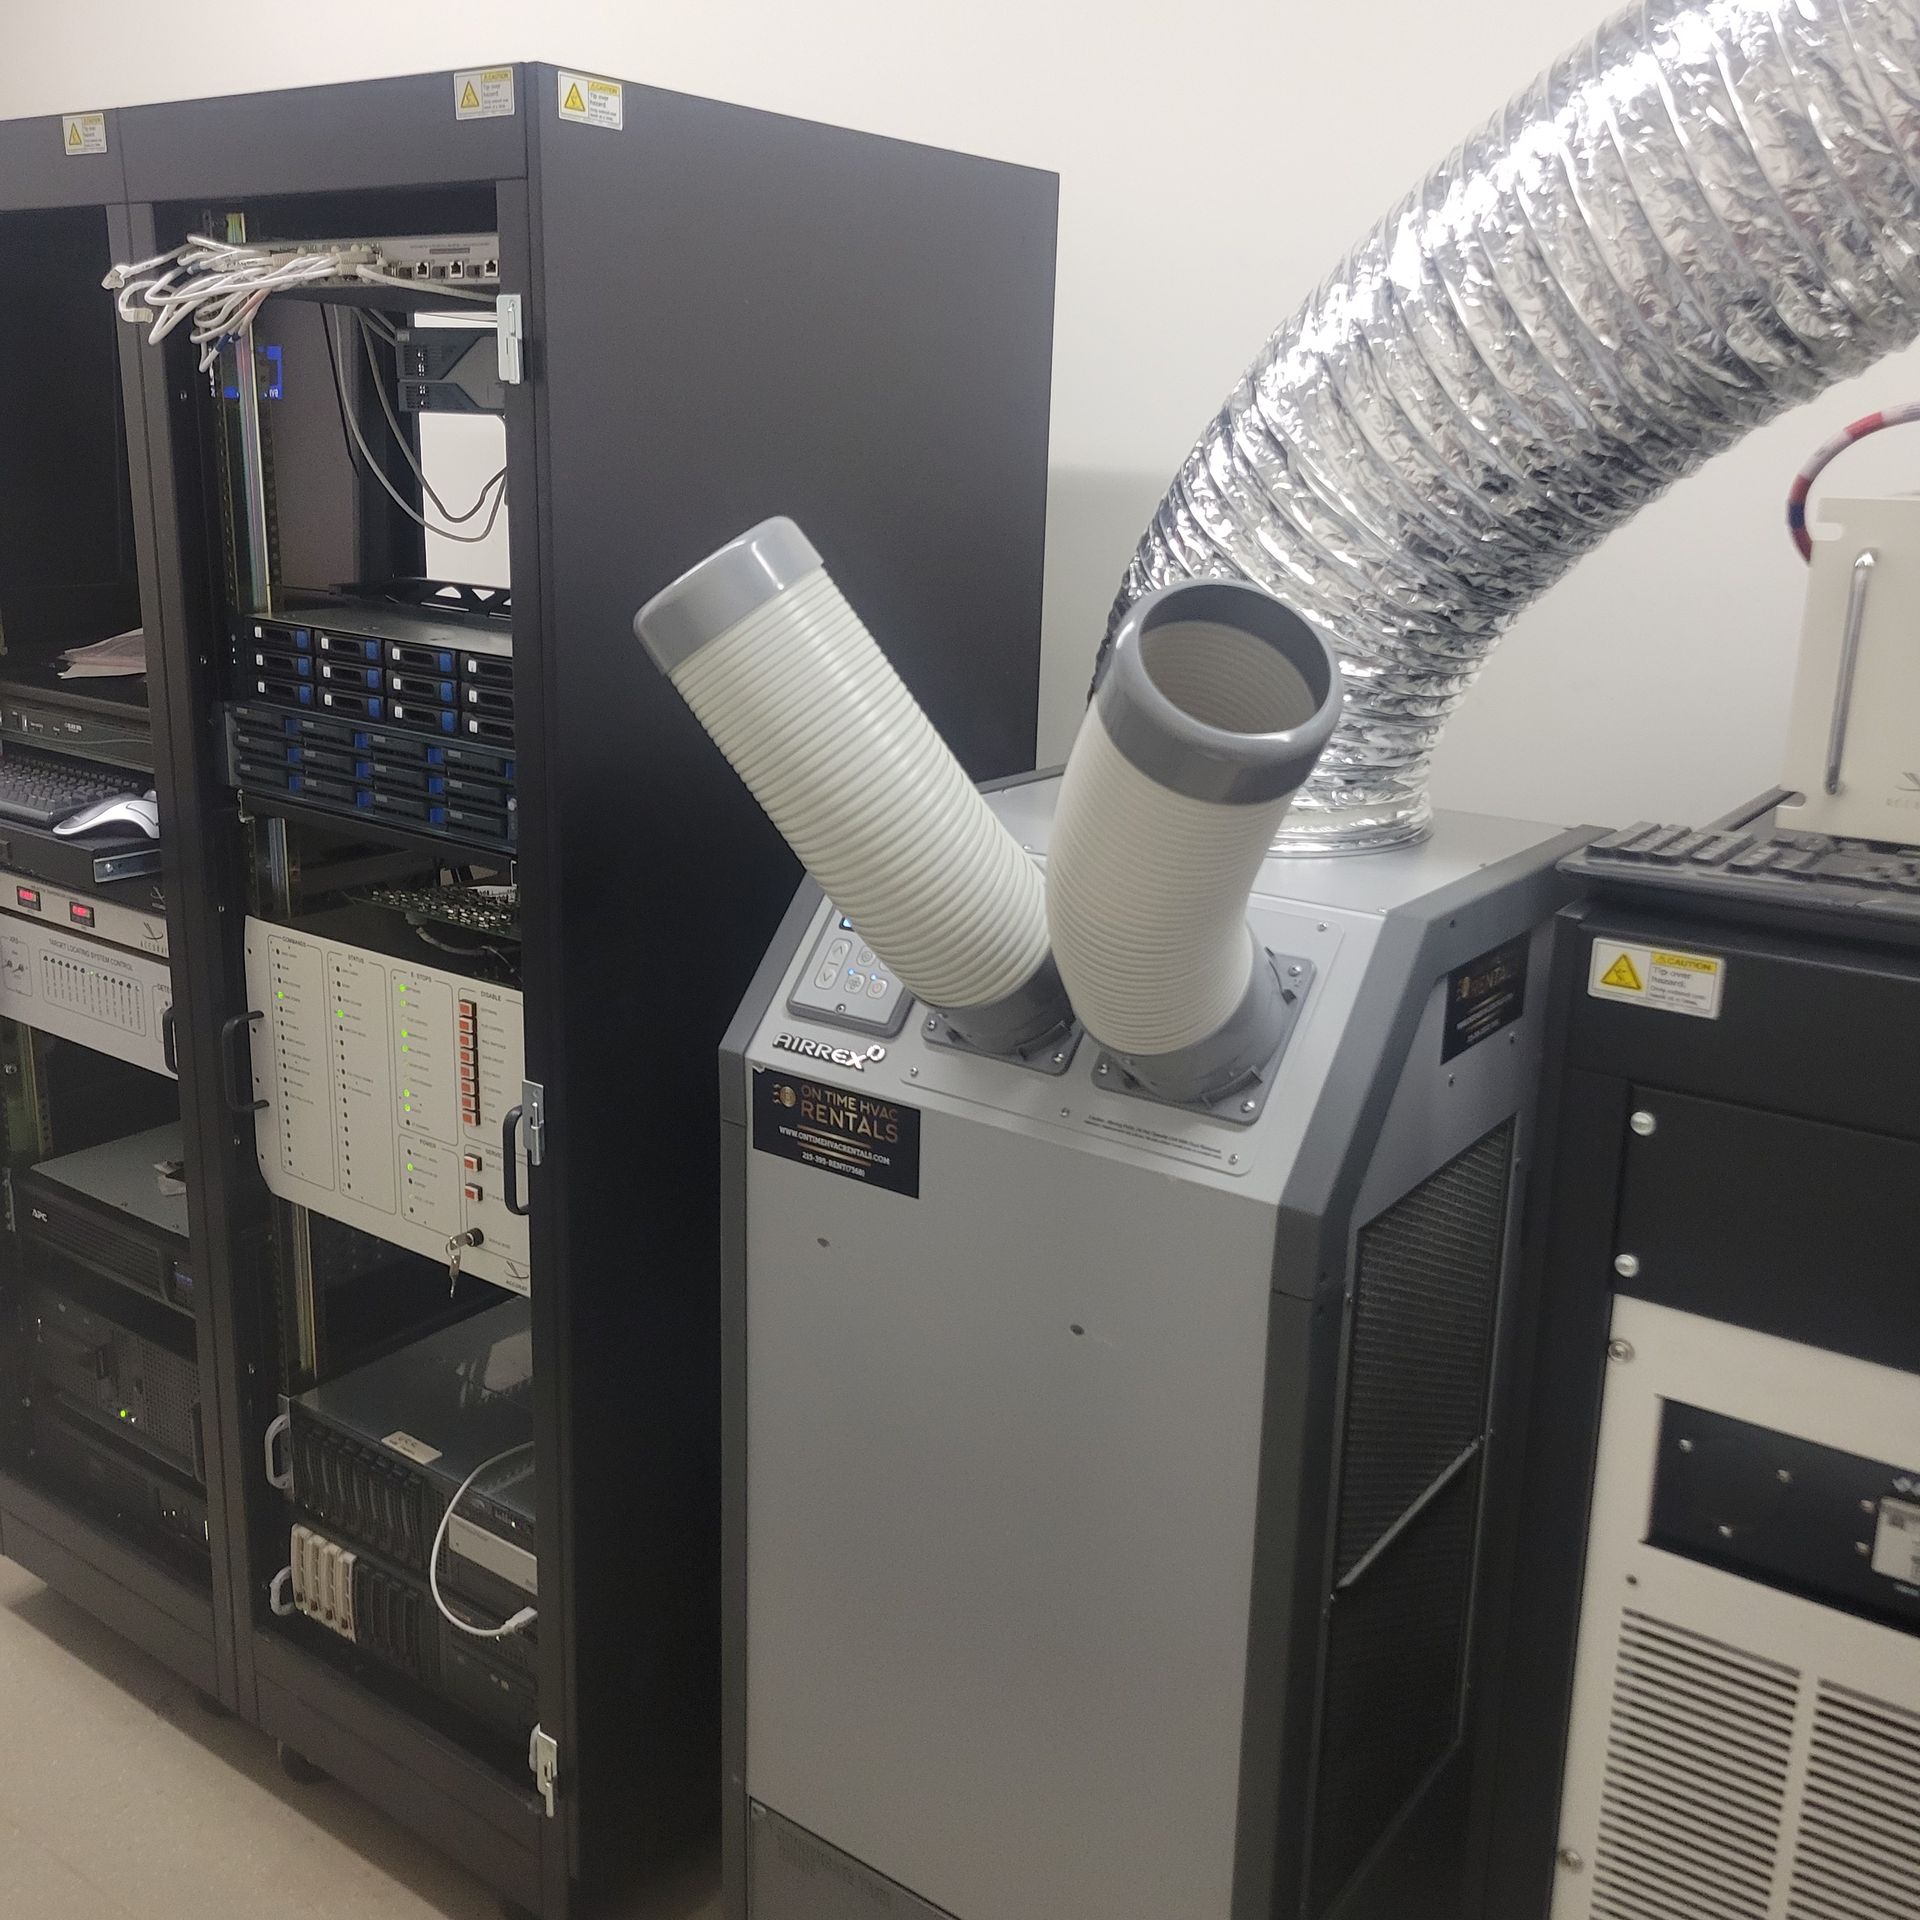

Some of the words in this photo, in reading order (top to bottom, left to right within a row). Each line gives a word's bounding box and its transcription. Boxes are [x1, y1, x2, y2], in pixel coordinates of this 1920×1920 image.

[91, 951, 110, 964] SYSTEM
[110, 958, 134, 972] CONTROL
[1666, 957, 1712, 971] CAUTION
[1653, 965, 1669, 977] Tip
[1669, 970, 1692, 980] over
[801, 1084, 822, 1102] ON
[824, 1089, 858, 1112] TIME
[859, 1100, 898, 1121] HVAC
[800, 1100, 899, 1144] RENTALS
[419, 1138, 437, 1150] POWER
[778, 1125, 891, 1166] WWW.ONTIMEHVACRENTALS.COM
[32, 1208, 48, 1222] APC
